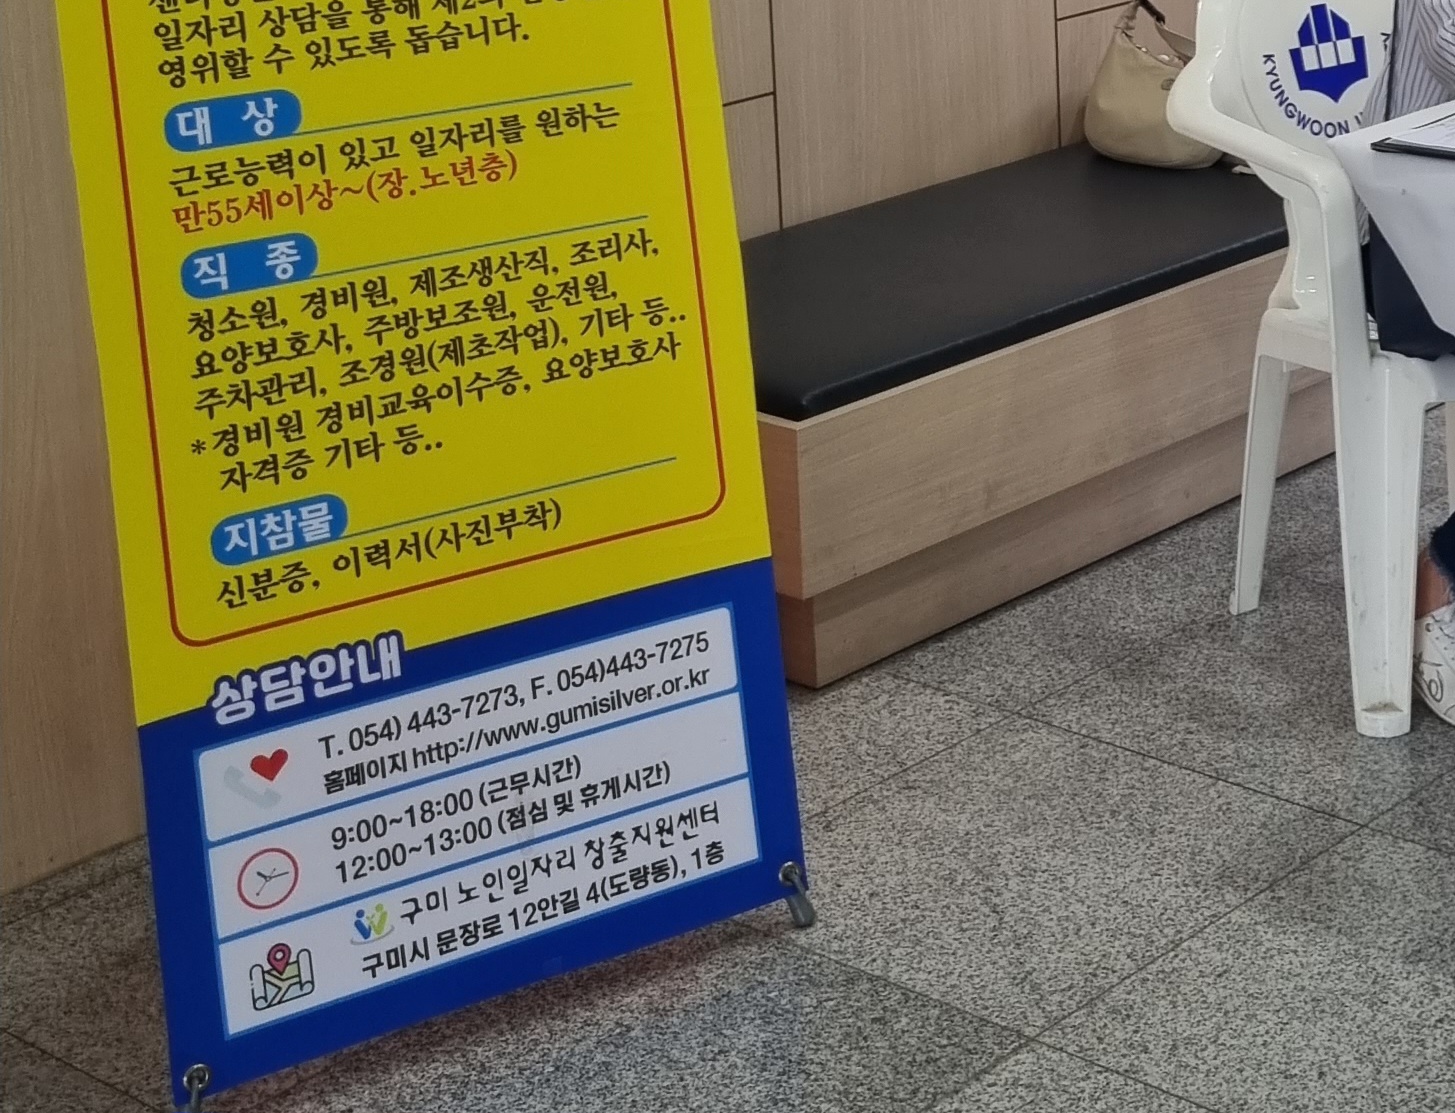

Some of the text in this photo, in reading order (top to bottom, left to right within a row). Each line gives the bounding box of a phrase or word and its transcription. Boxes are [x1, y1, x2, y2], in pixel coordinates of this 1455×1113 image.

[153, 11, 247, 52] 일자리
[158, 12, 530, 88] 영위할 수 있도록 돕습니다.
[1262, 54, 1351, 138] KYUNGWOON
[169, 102, 621, 198] 근로능력이 있고 일자리를 원하는
[188, 227, 659, 343] 청소원, 경비원, 제조생산직, 조리사,
[191, 271, 618, 380] 요양보호사, 주방보조원, 운전원,
[194, 366, 327, 420] 주차관리,
[579, 302, 634, 338] 기타
[316, 365, 531, 434] 경비교육이수증,
[541, 331, 682, 384] 요양보호사
[220, 448, 315, 493] 자격증
[325, 431, 385, 470] 기타
[216, 497, 562, 610] 신분증, 이력서(사진부착)
[224, 502, 333, 559] 지참물
[211, 636, 403, 724] 상담안내
[318, 735, 344, 759] T.
[348, 715, 402, 751] 054)
[407, 684, 526, 735] 443-7273,
[531, 676, 553, 700] F.
[323, 751, 408, 795] 홈페이지
[331, 754, 582, 851] 9:00~18:00 (근무시간)
[336, 760, 671, 884] 12:00~13:00 (점심 및 휴게시간)
[400, 800, 721, 926] 구미 노인일자리 창출지원센터
[362, 936, 429, 980] 구미시
[436, 912, 502, 955] 문장로
[508, 892, 581, 932] 12안길
[694, 840, 726, 870] 1층
